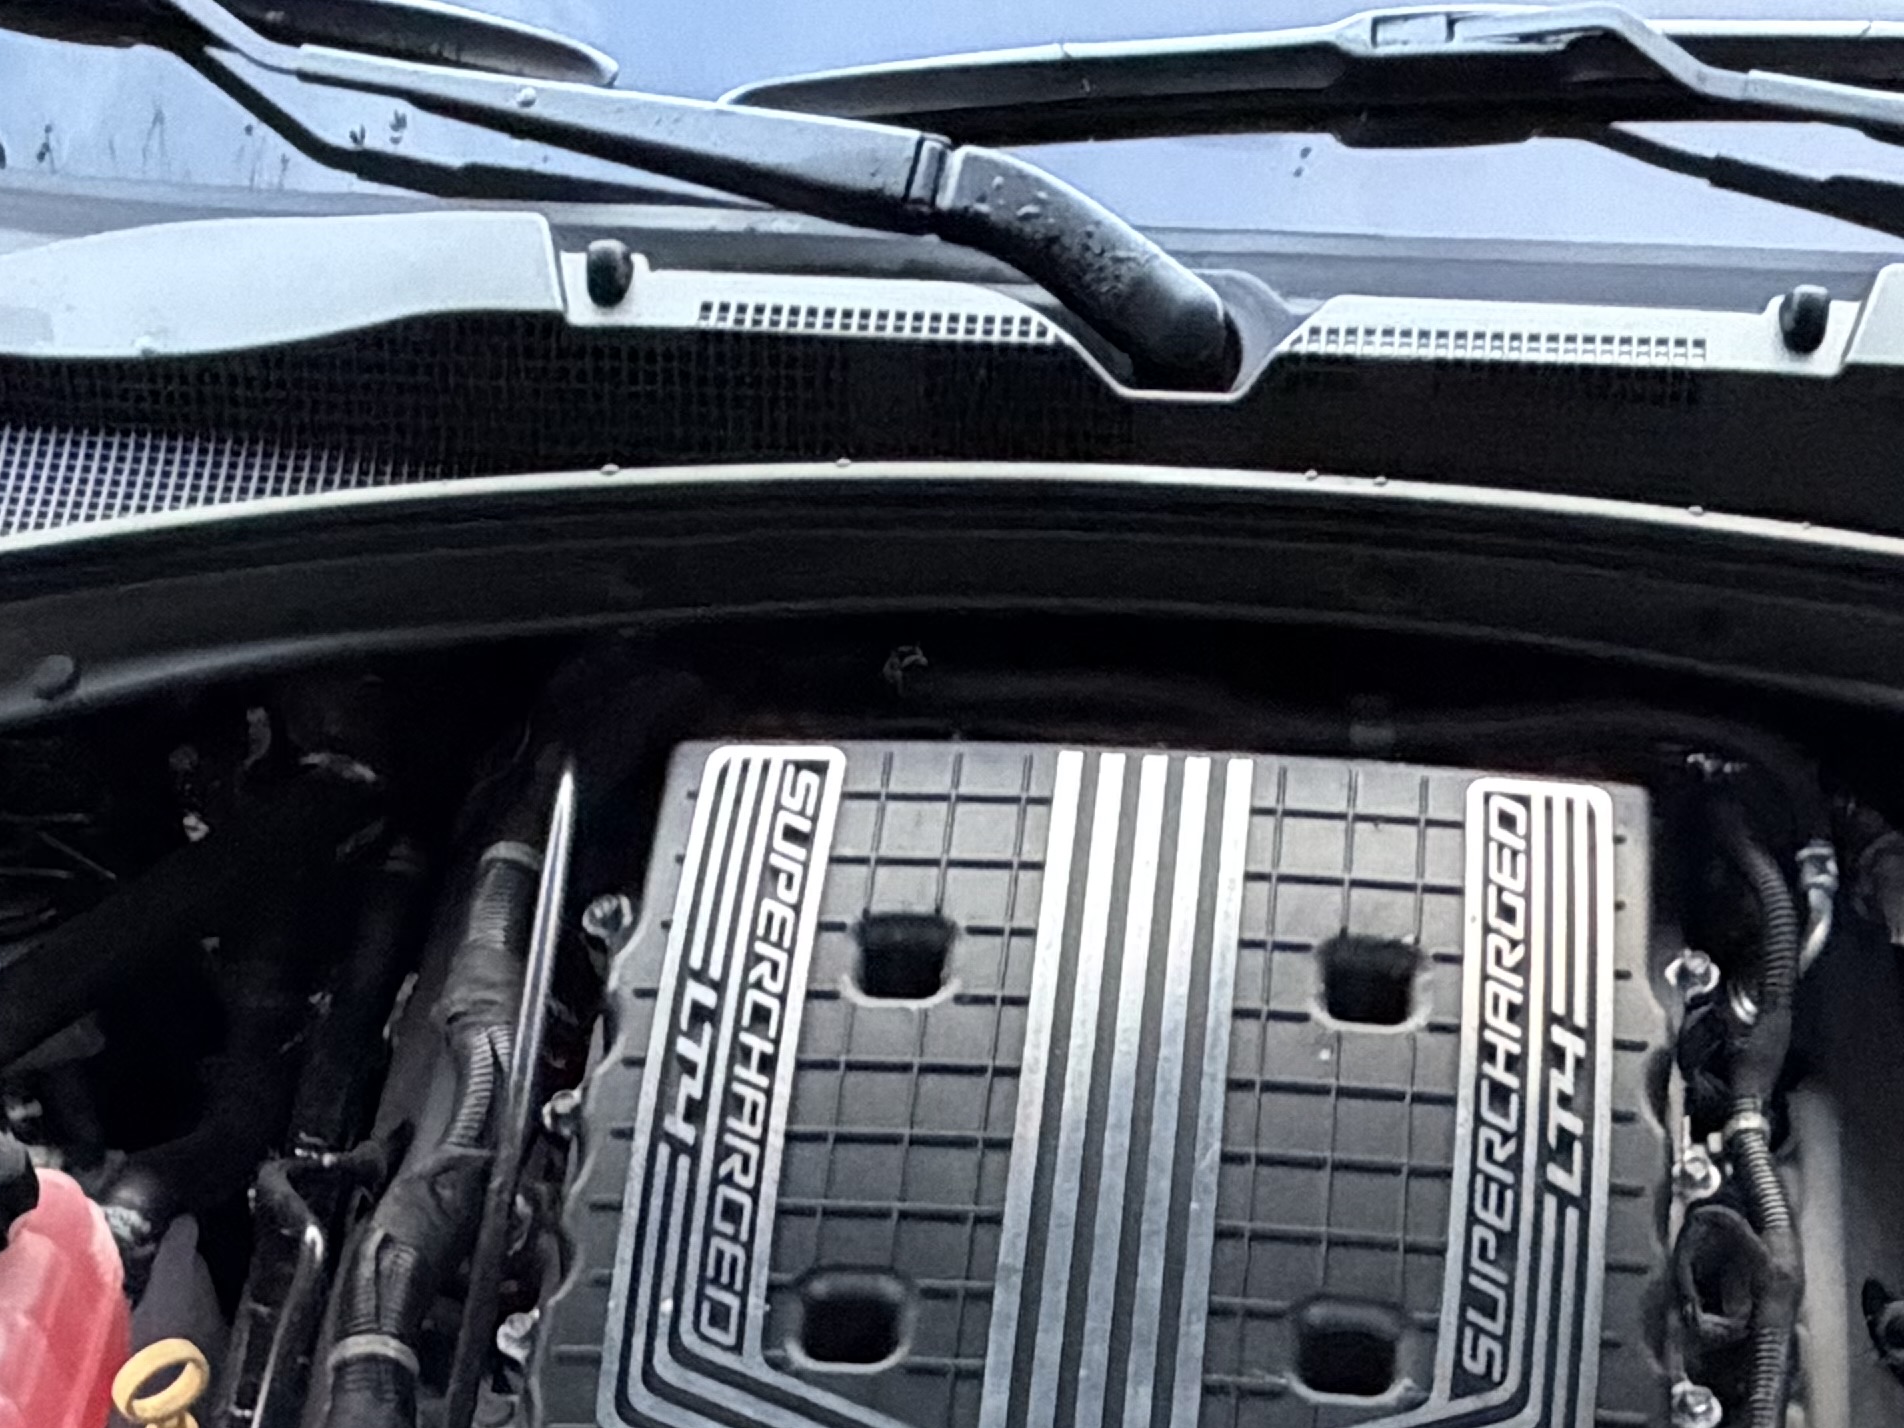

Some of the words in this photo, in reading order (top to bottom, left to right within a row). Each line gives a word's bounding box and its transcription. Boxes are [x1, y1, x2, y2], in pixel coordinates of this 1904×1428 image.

[663, 980, 718, 1147] LT4
[698, 763, 819, 1348] SUPERCHARGED
[1462, 792, 1528, 1384] SUPERCHARGED
[1546, 1022, 1587, 1198] LT4
